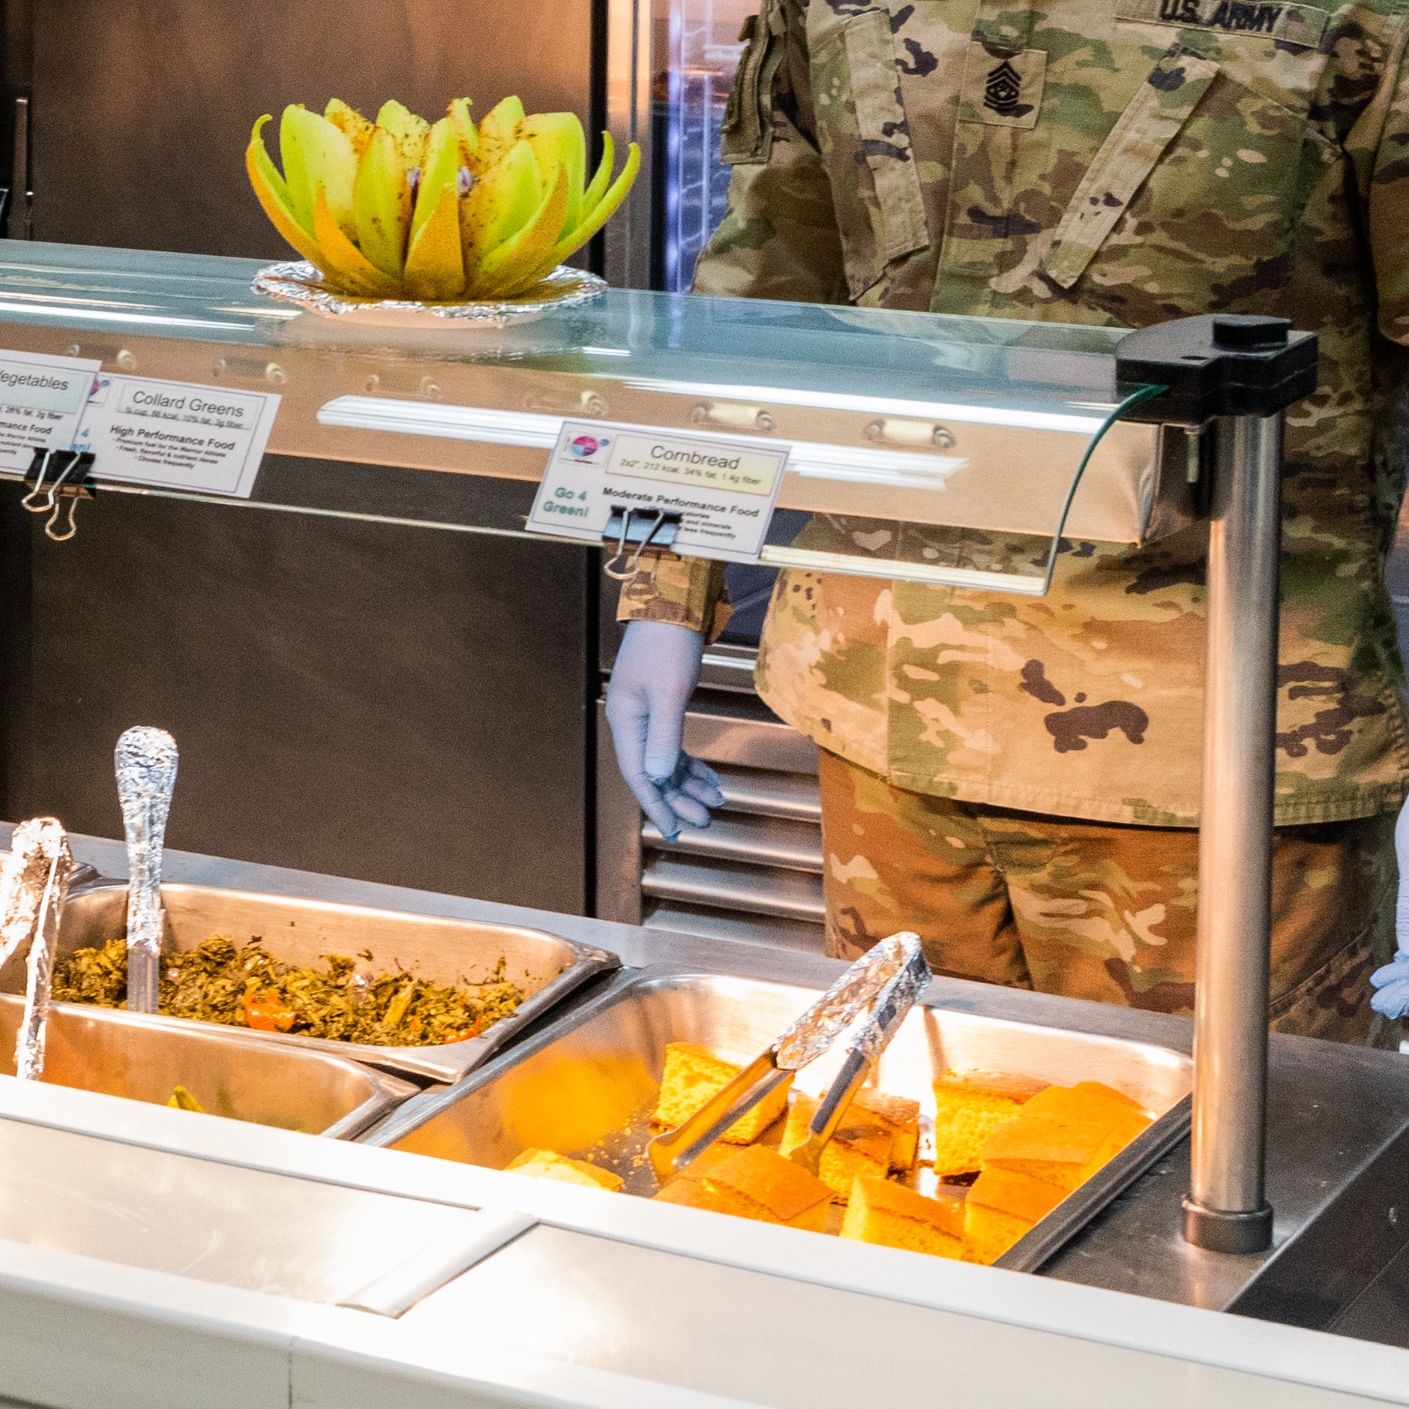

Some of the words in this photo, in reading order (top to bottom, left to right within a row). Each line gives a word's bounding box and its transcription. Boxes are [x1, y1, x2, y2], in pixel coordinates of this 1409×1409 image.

[1209, 0, 1284, 34] ARMY
[133, 390, 186, 409] Collard
[189, 398, 244, 418] Greens
[29, 423, 53, 435] Food
[81, 428, 90, 438] 4
[109, 424, 134, 437] High
[136, 428, 205, 447] Performance
[207, 437, 236, 451] Food
[650, 445, 741, 470] Cornbread
[643, 462, 660, 471] 212
[741, 475, 762, 485] fiber
[554, 486, 574, 499] Go
[577, 490, 588, 501] 4
[602, 487, 653, 503] Moderate
[656, 494, 727, 514] Performance
[730, 505, 761, 518] Food
[543, 500, 590, 518] Green!
